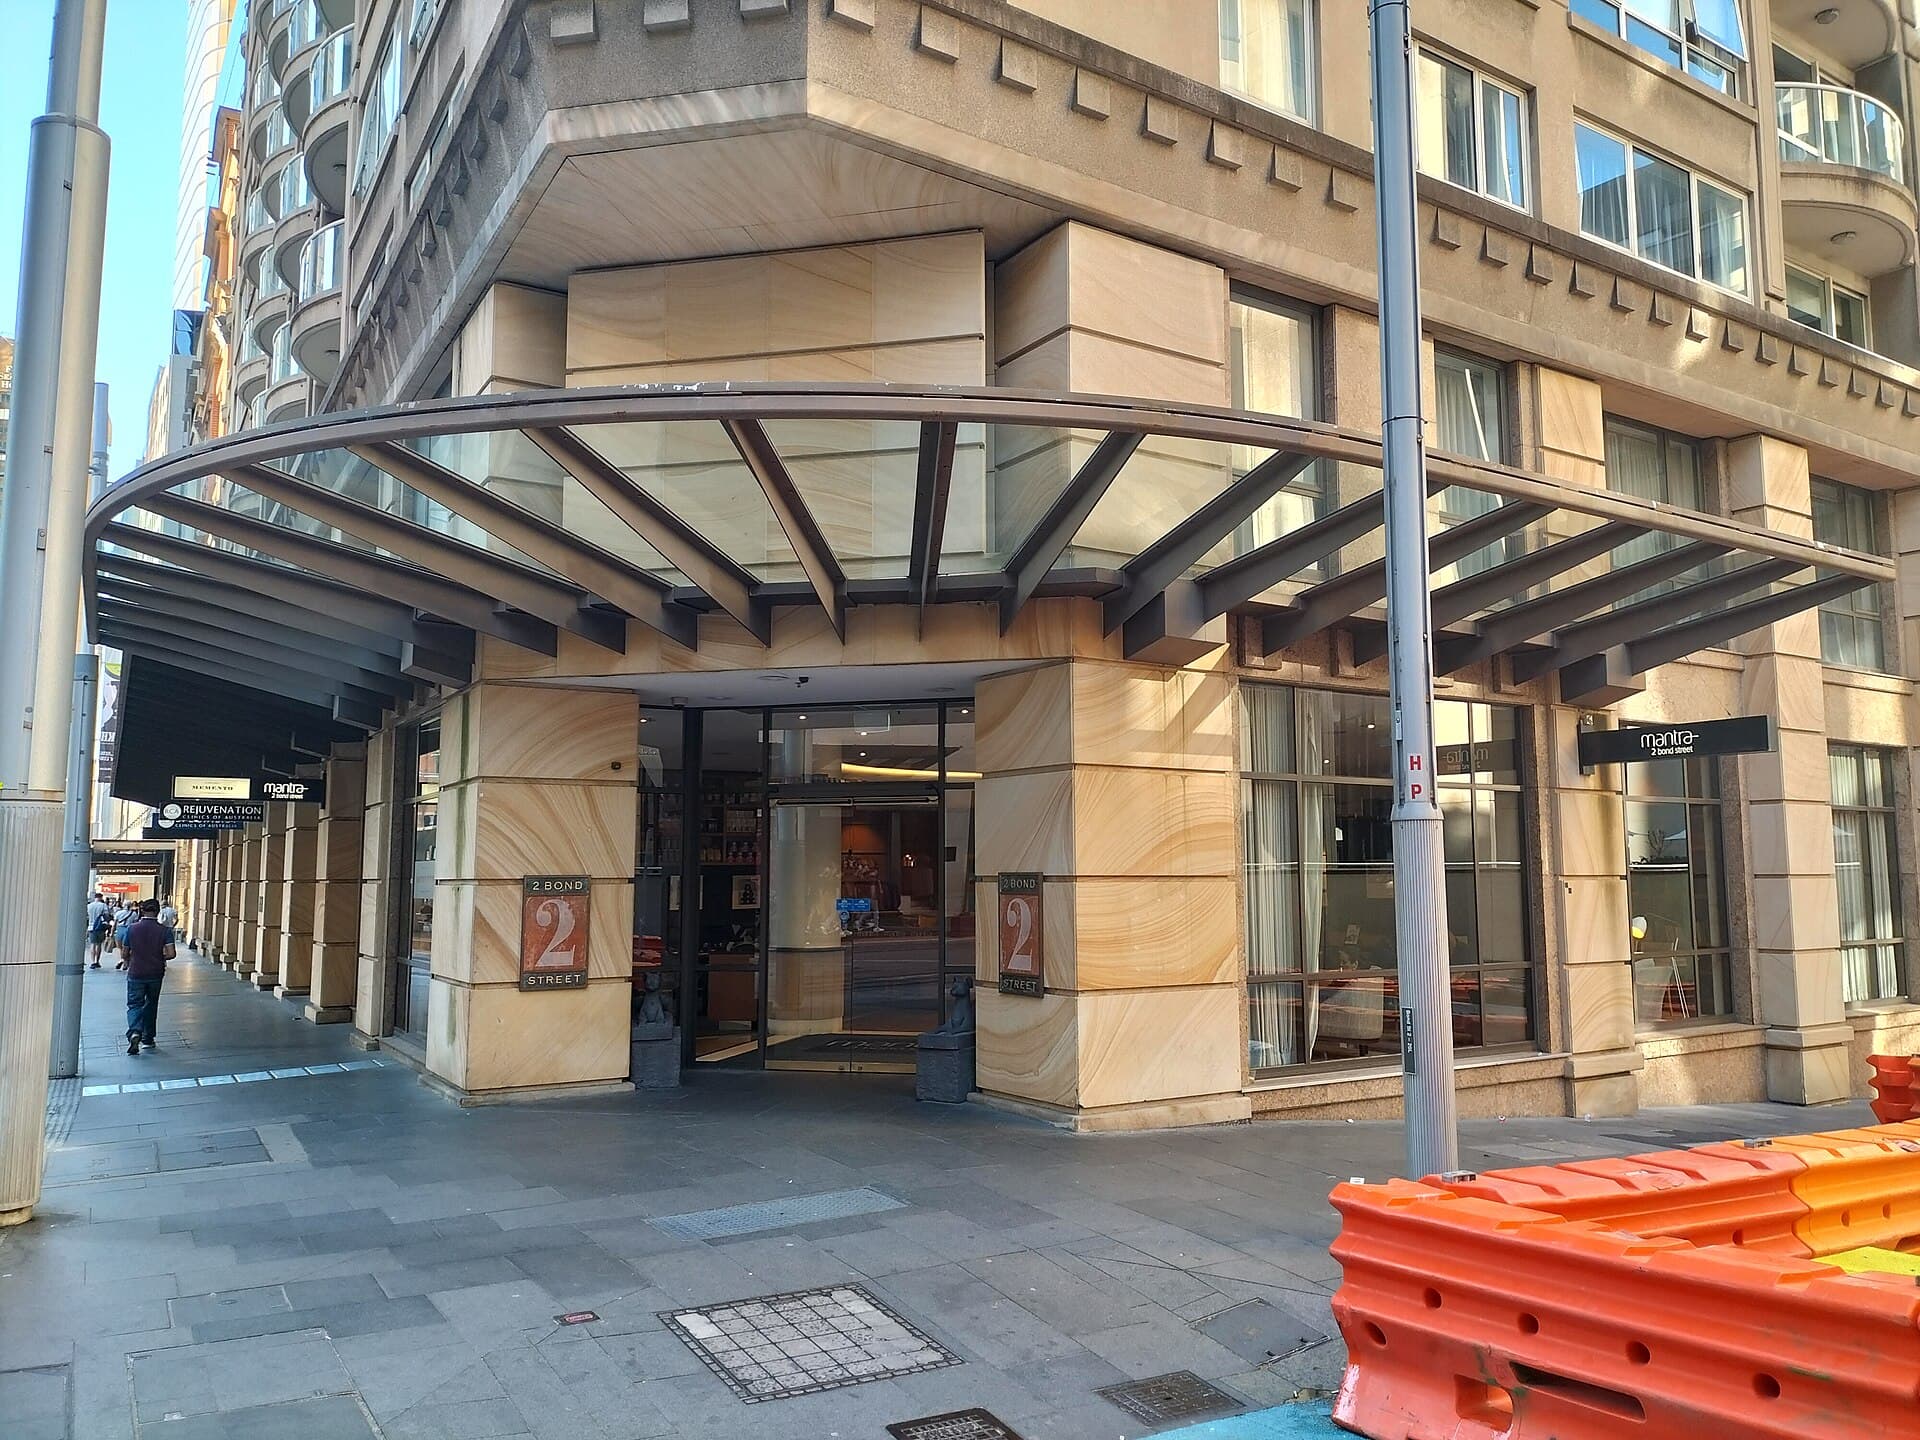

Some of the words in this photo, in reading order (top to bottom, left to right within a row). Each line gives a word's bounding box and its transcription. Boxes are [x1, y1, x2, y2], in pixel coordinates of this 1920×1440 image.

[1640, 729, 1699, 748] mantra
[1651, 747, 1657, 756] 2
[1657, 747, 1674, 756] bond
[1674, 745, 1694, 754] street
[1409, 755, 1422, 771] H
[263, 782, 309, 794] mantra
[1410, 784, 1422, 800] P
[183, 805, 262, 815] REJUVENATION
[532, 881, 540, 891] 2
[544, 881, 583, 892] BOND
[1003, 880, 1010, 889] 2
[1010, 879, 1036, 889] BOND
[535, 898, 576, 967] 2
[1007, 897, 1033, 971] 2
[527, 974, 581, 985] STREET
[1003, 979, 1037, 993] STREET
